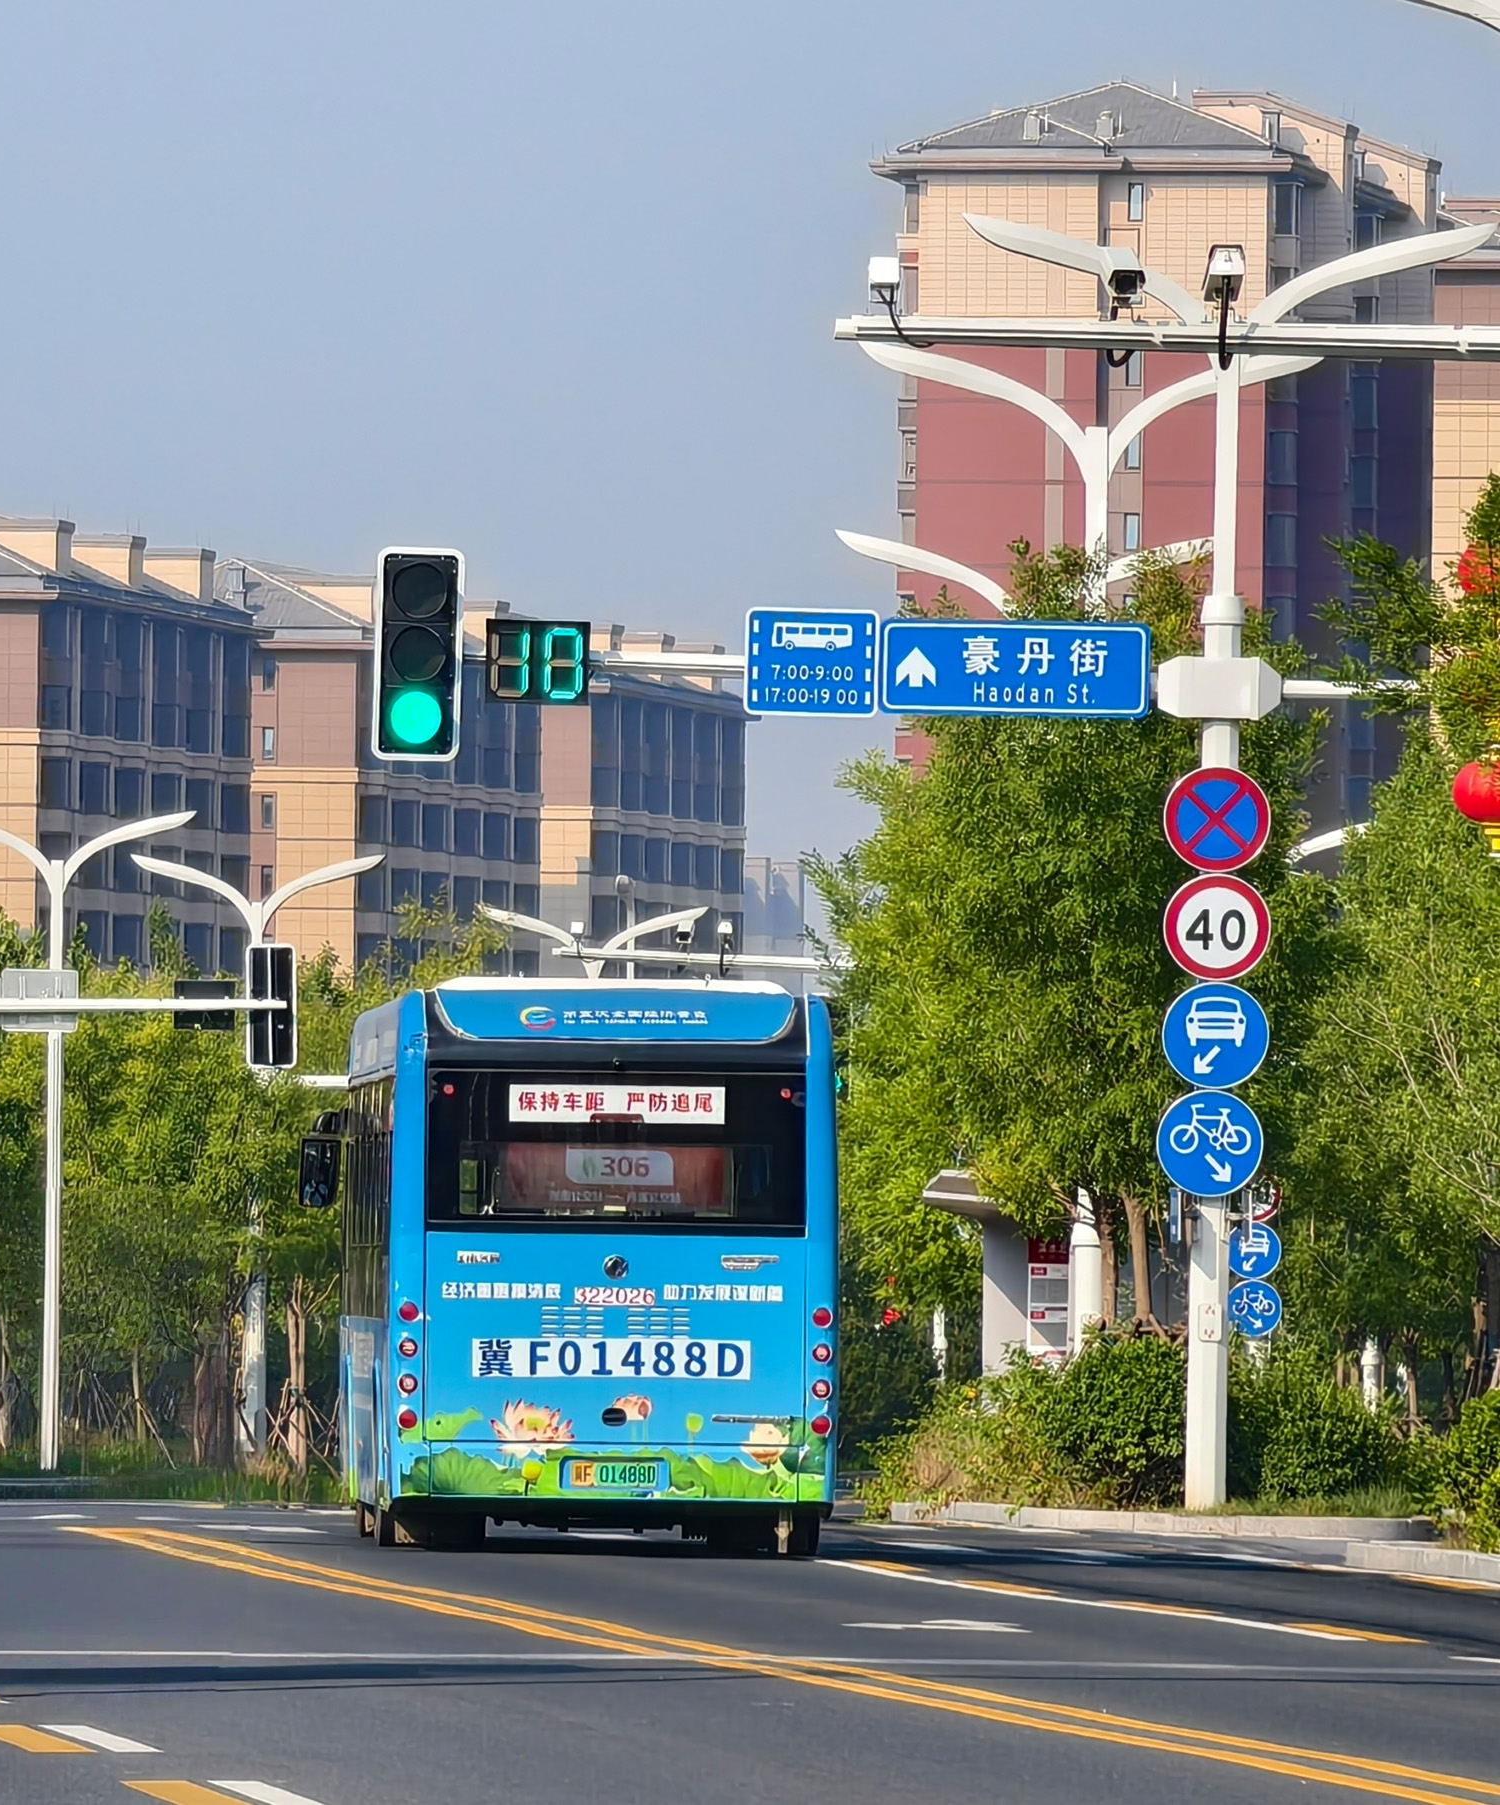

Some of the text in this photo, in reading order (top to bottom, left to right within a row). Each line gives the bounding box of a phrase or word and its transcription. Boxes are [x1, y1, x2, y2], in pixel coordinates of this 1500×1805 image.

[519, 627, 584, 700] 10
[962, 635, 1109, 678] 豪丹街
[770, 664, 854, 681] 7:00-9:00
[765, 686, 858, 705] 17:00-1900
[973, 681, 1096, 704] Haodan St.
[1185, 909, 1246, 951] 40
[518, 1091, 714, 1113] 保持车距 严防追尾
[600, 1156, 650, 1178] 306
[576, 1286, 655, 1304] 322026
[478, 1339, 745, 1377] 冀F01488D
